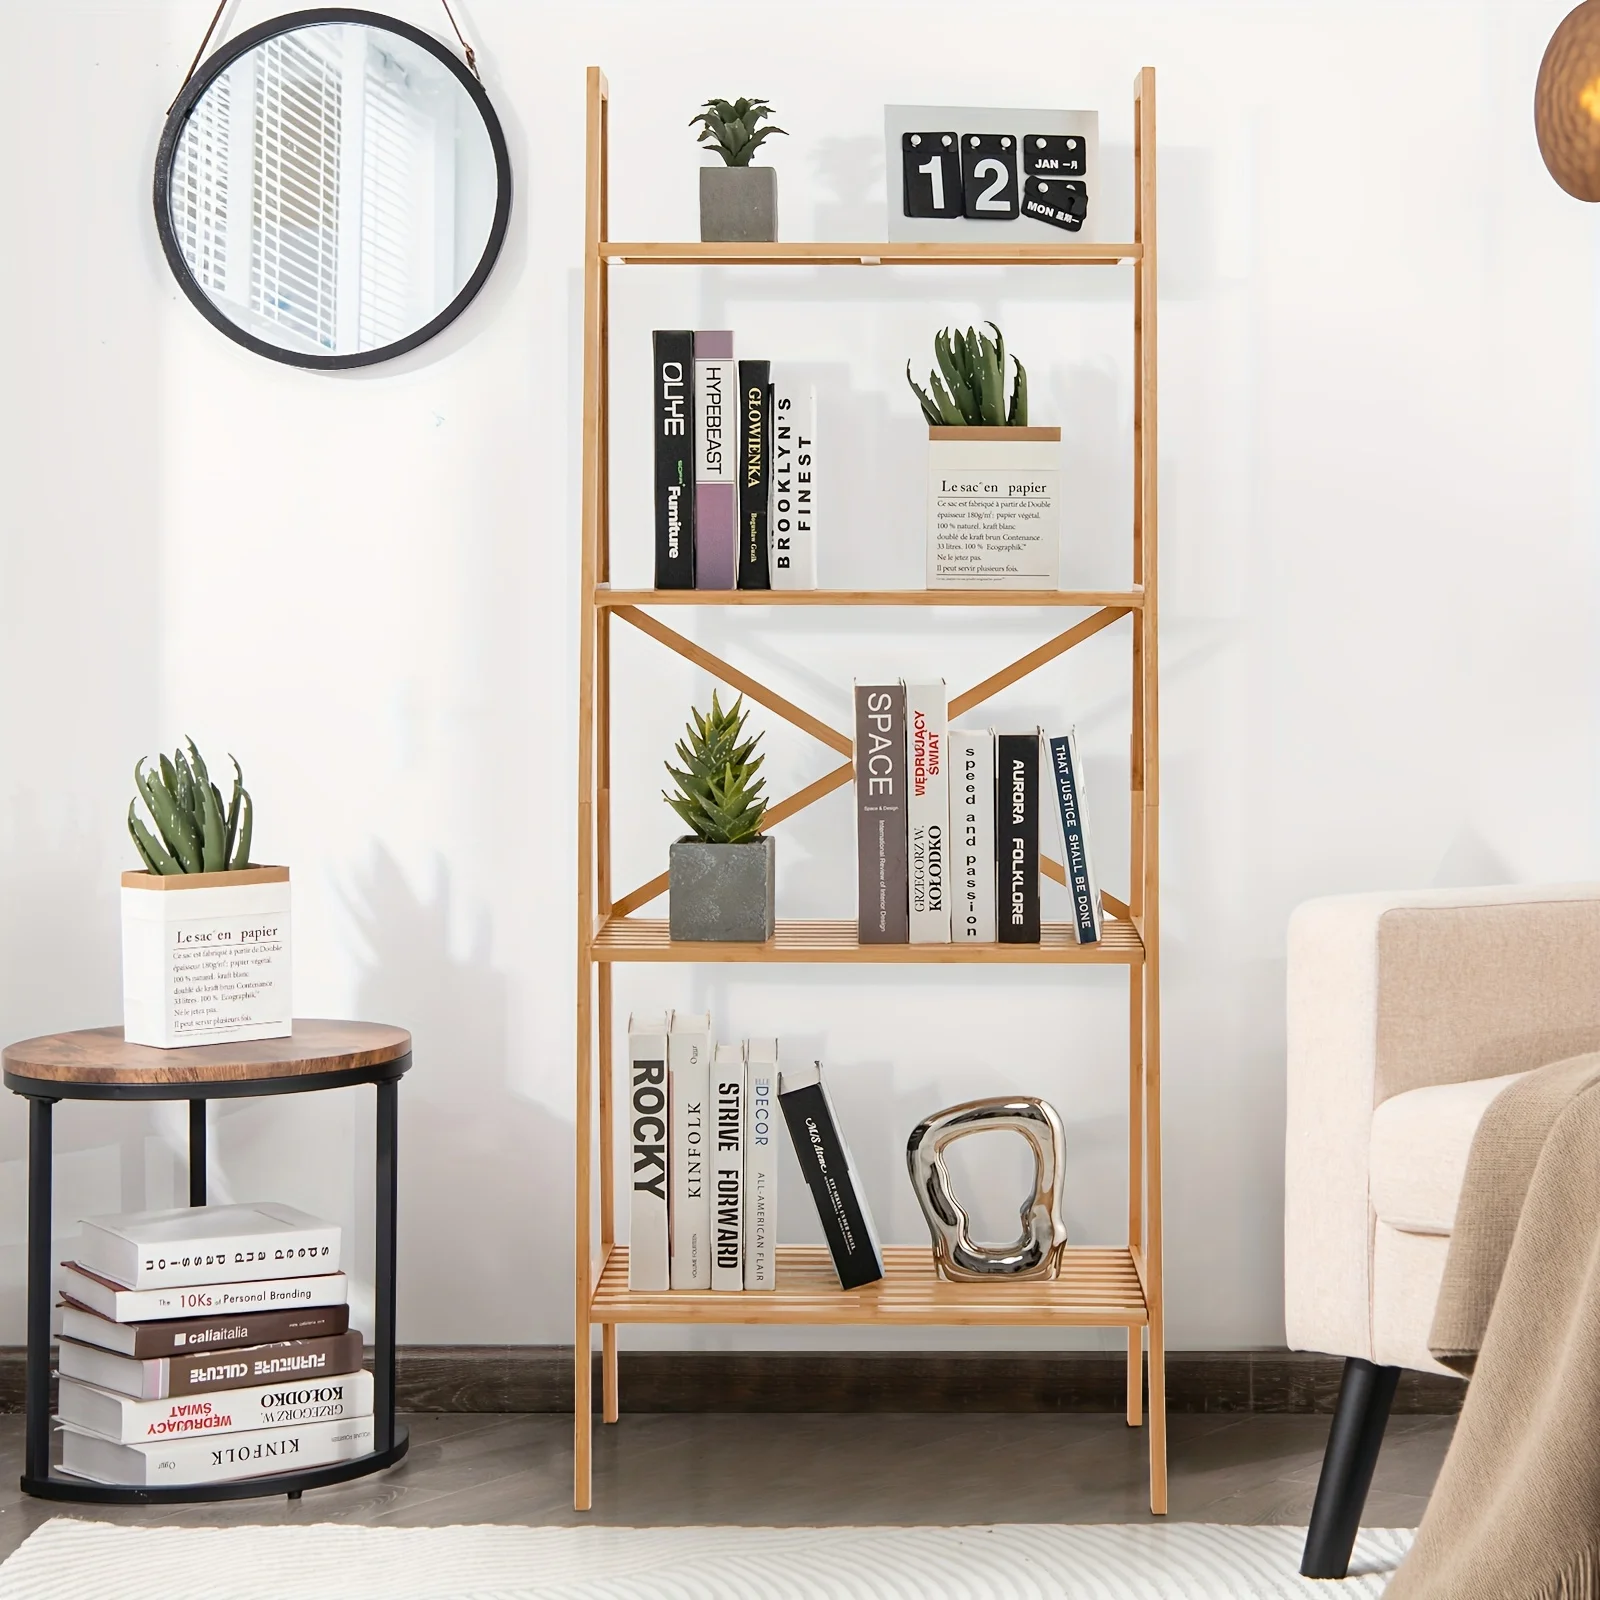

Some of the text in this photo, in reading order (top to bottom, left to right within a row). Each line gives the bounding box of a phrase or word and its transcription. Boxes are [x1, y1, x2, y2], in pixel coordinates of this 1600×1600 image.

[919, 156, 1010, 211] 1 2
[1035, 159, 1077, 170] JAN 一月
[1027, 201, 1079, 223] MON 星期一
[706, 367, 721, 474] HYPEBEAST
[747, 387, 762, 487] GŁOWIENKA
[777, 398, 791, 568] BROOKLYN'S
[798, 436, 812, 531] FINEST
[942, 480, 957, 492] Le
[1008, 482, 1047, 496] papier
[969, 500, 994, 509] fabriqué
[668, 486, 682, 559] Furniture
[937, 512, 965, 520] épaisseur
[996, 512, 1016, 520] papier
[750, 544, 758, 563] Guzik
[954, 554, 968, 562] jetez
[867, 693, 892, 795] SPACE
[926, 732, 939, 775] ŚWIAT
[965, 748, 977, 936] speed and passion
[1012, 760, 1024, 925] AURORA FOLKLORE
[1056, 745, 1091, 928] THAT JUSTICE SHALL BE DONE
[914, 825, 924, 912] GRZEGORZ W.
[928, 825, 942, 911] KOŁODKO
[177, 931, 192, 943] Le
[218, 932, 231, 941] en
[241, 926, 278, 942] papier
[633, 1060, 665, 1200] ROCKY
[688, 1102, 701, 1198] KINFOLK
[717, 1083, 739, 1268] STRIVE FORWARD
[756, 1172, 765, 1281] ALL-AMERICAN FLAIR
[146, 1246, 329, 1271] speed and passion
[180, 1294, 212, 1308] 10Ks
[223, 1291, 266, 1303] Personal
[270, 1288, 312, 1300] Branding
[169, 1403, 212, 1417] ŚWIAT
[260, 1386, 343, 1408] KOŁODKO
[277, 1404, 343, 1421] GRZEGORZ
[212, 1438, 299, 1466] KINFOLK
